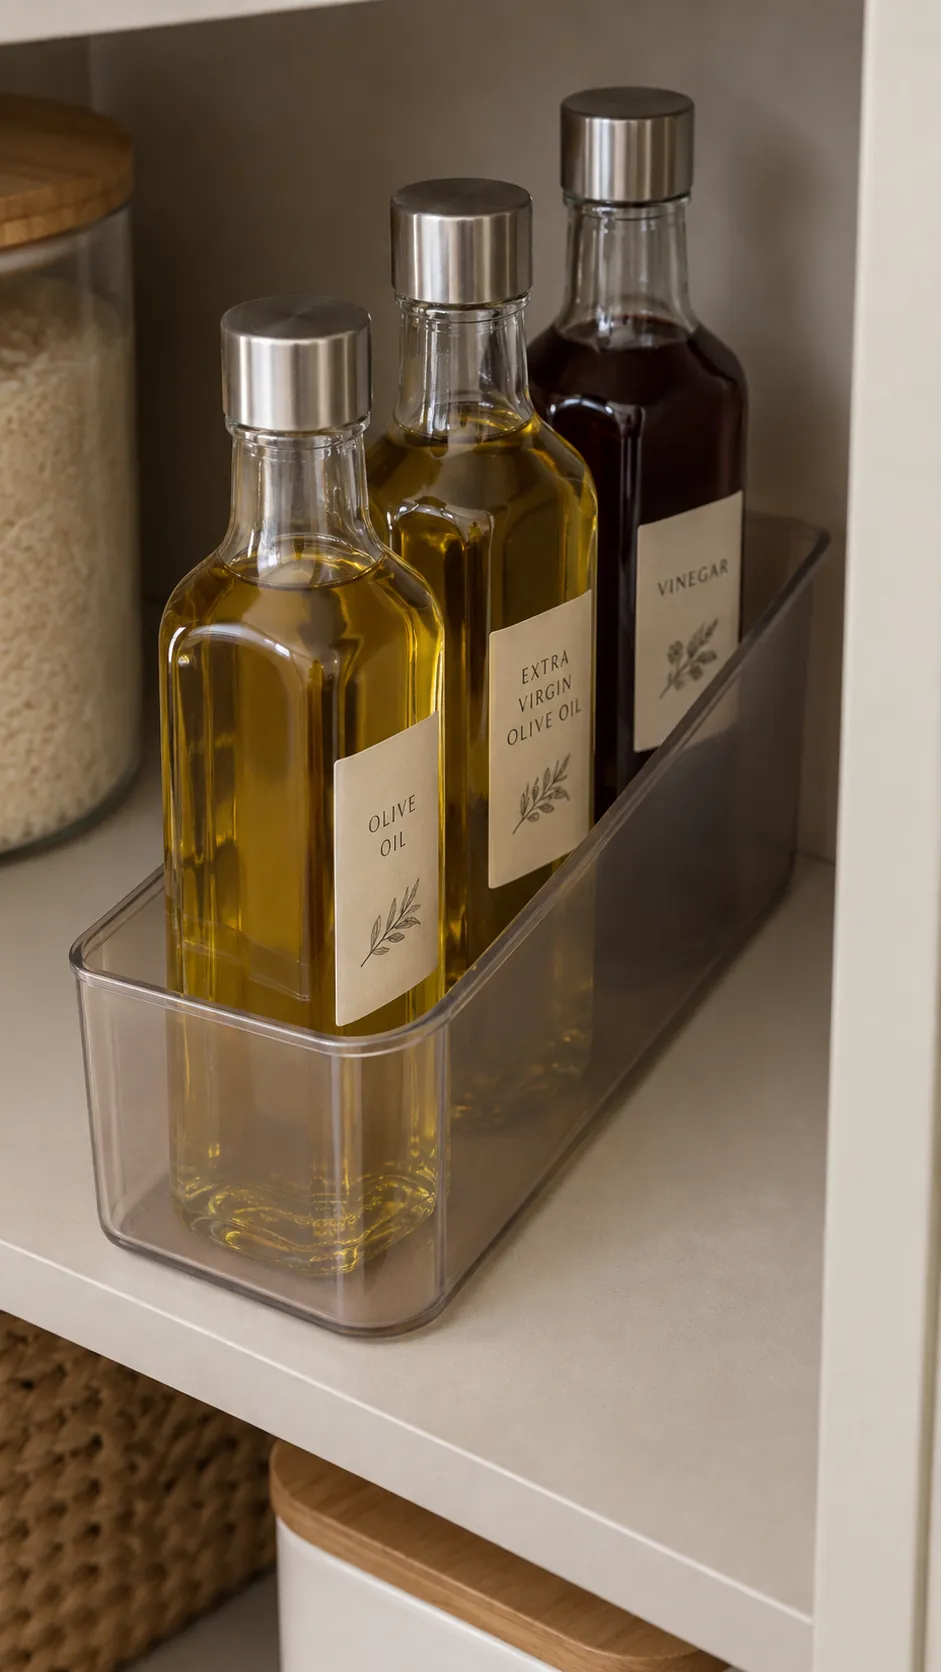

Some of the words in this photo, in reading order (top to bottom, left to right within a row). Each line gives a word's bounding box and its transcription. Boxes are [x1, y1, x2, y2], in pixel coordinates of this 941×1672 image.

[657, 558, 729, 597] VINEGAR
[521, 650, 569, 685] EXTRA
[518, 674, 572, 713] VIRGIN
[506, 711, 552, 746] OLIVE
[558, 698, 582, 722] OIL
[368, 793, 416, 833] OLIVE
[380, 831, 406, 857] OIL
